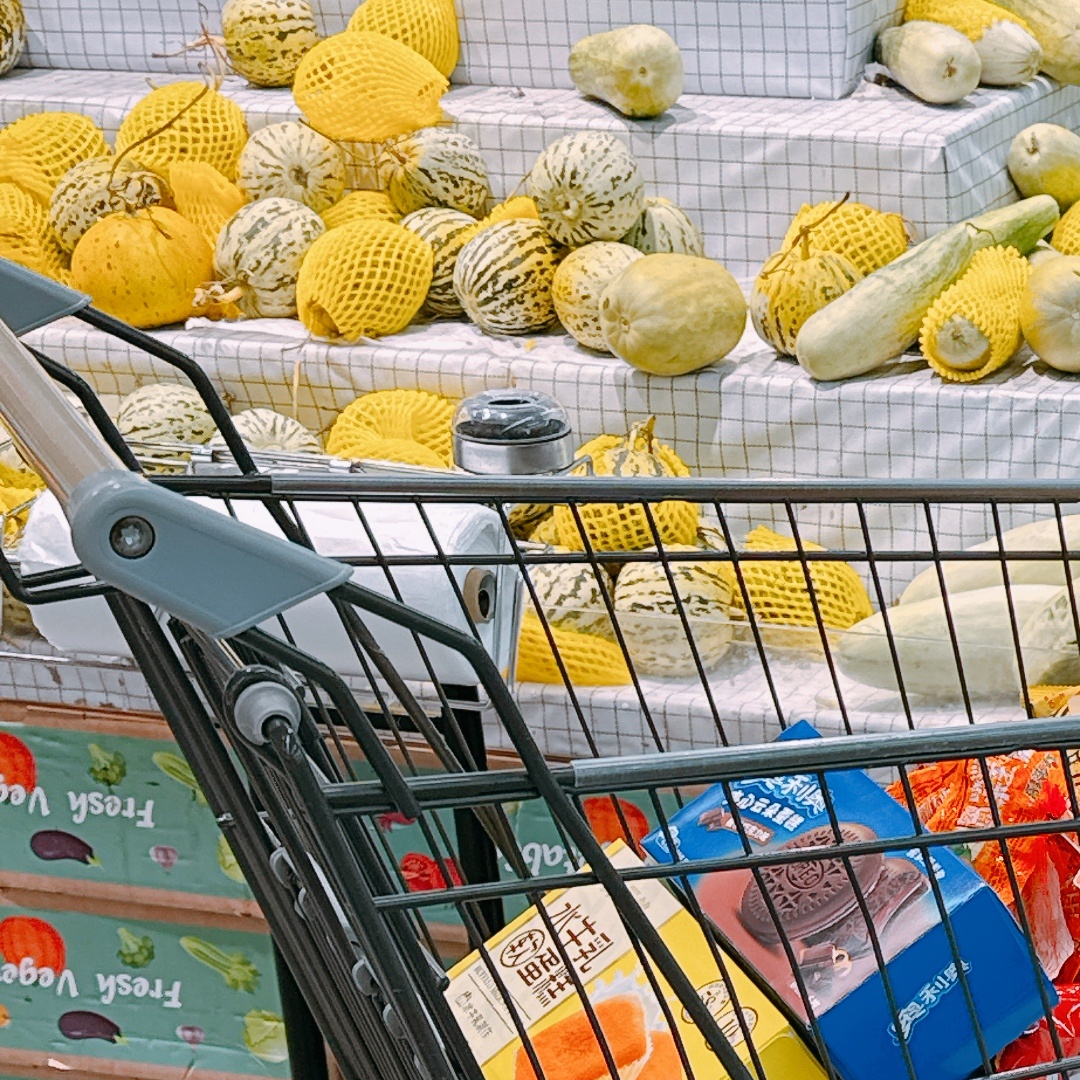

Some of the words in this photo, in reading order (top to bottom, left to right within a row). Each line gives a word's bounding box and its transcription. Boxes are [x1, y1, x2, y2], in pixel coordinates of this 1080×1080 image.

[68, 790, 154, 829] Fresh
[548, 902, 615, 974] 水牛乳
[96, 972, 182, 1008] Fresh
[500, 928, 575, 1008] 软蛋糕
